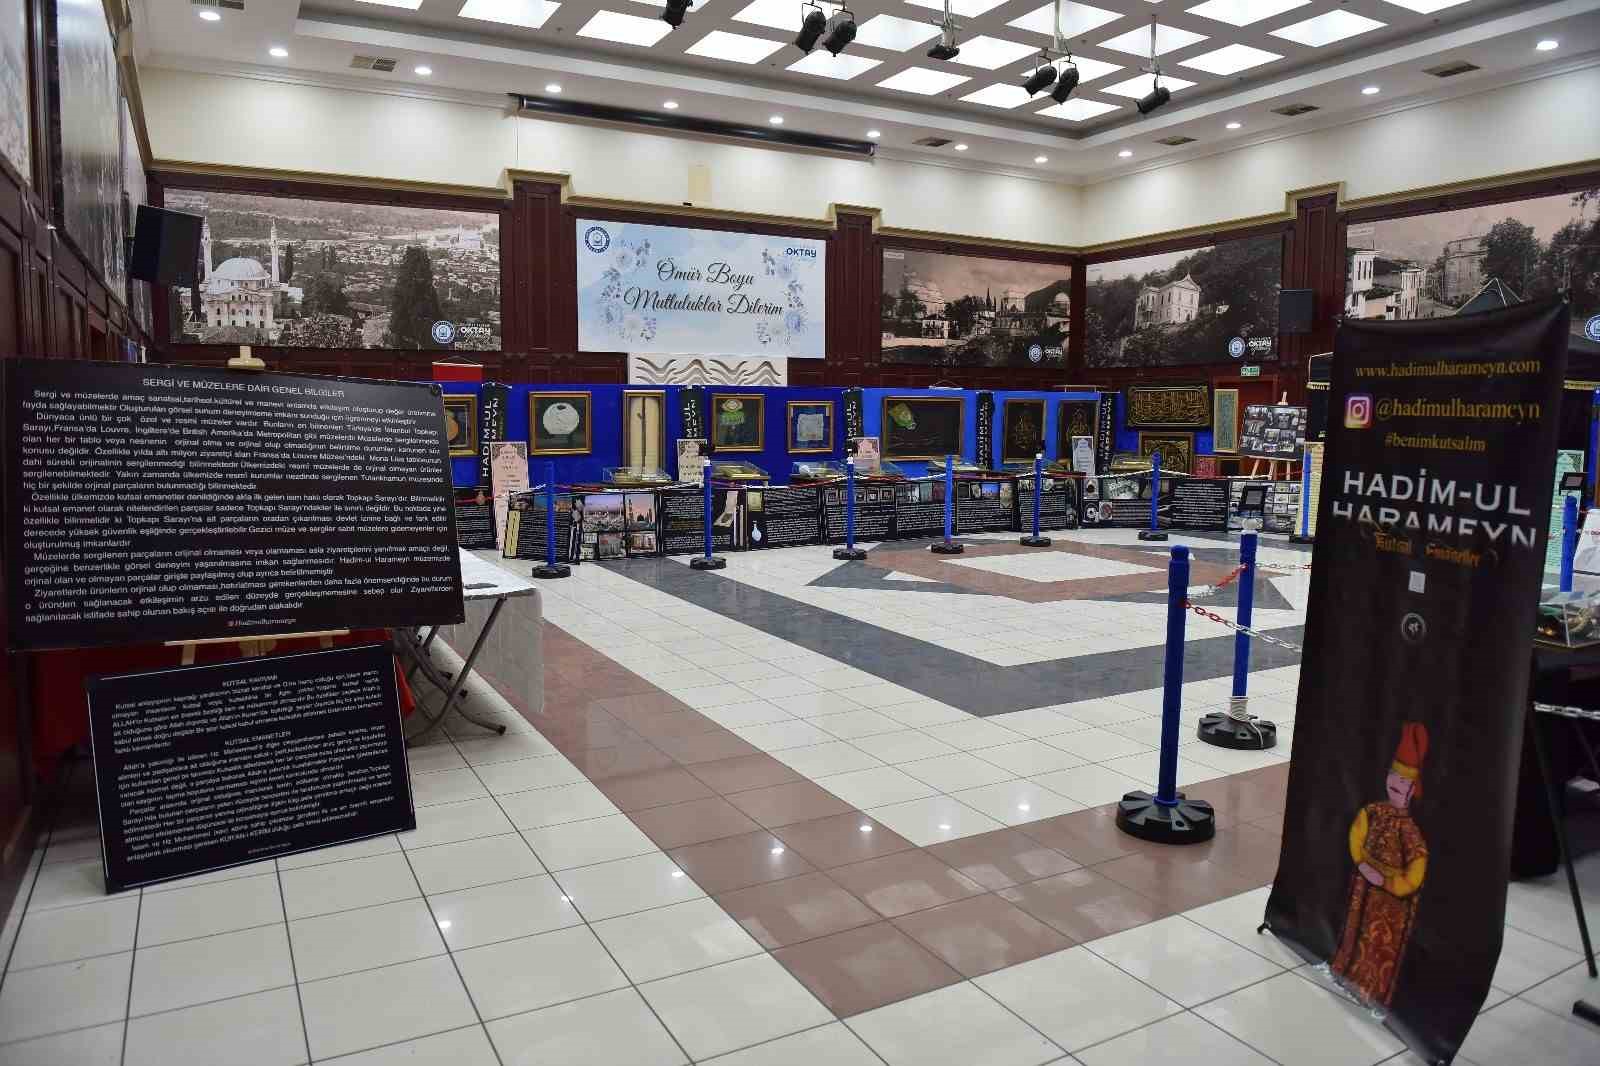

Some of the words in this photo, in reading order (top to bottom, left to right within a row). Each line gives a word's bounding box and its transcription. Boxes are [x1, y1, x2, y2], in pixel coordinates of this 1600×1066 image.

[786, 247, 817, 258] OKTAY
[656, 257, 702, 282] Ömür
[706, 262, 755, 291] Boyu
[623, 286, 723, 313] Mutluluklar
[726, 293, 784, 316] Dilerim
[1354, 359, 1541, 378] www.hadimulharameyn.com
[143, 377, 175, 387] SERGİ
[247, 383, 270, 392] DAİR
[271, 385, 303, 395] GENEL
[1375, 398, 1541, 424] @hadimulharameyn
[1343, 468, 1531, 516] HADİM-UL
